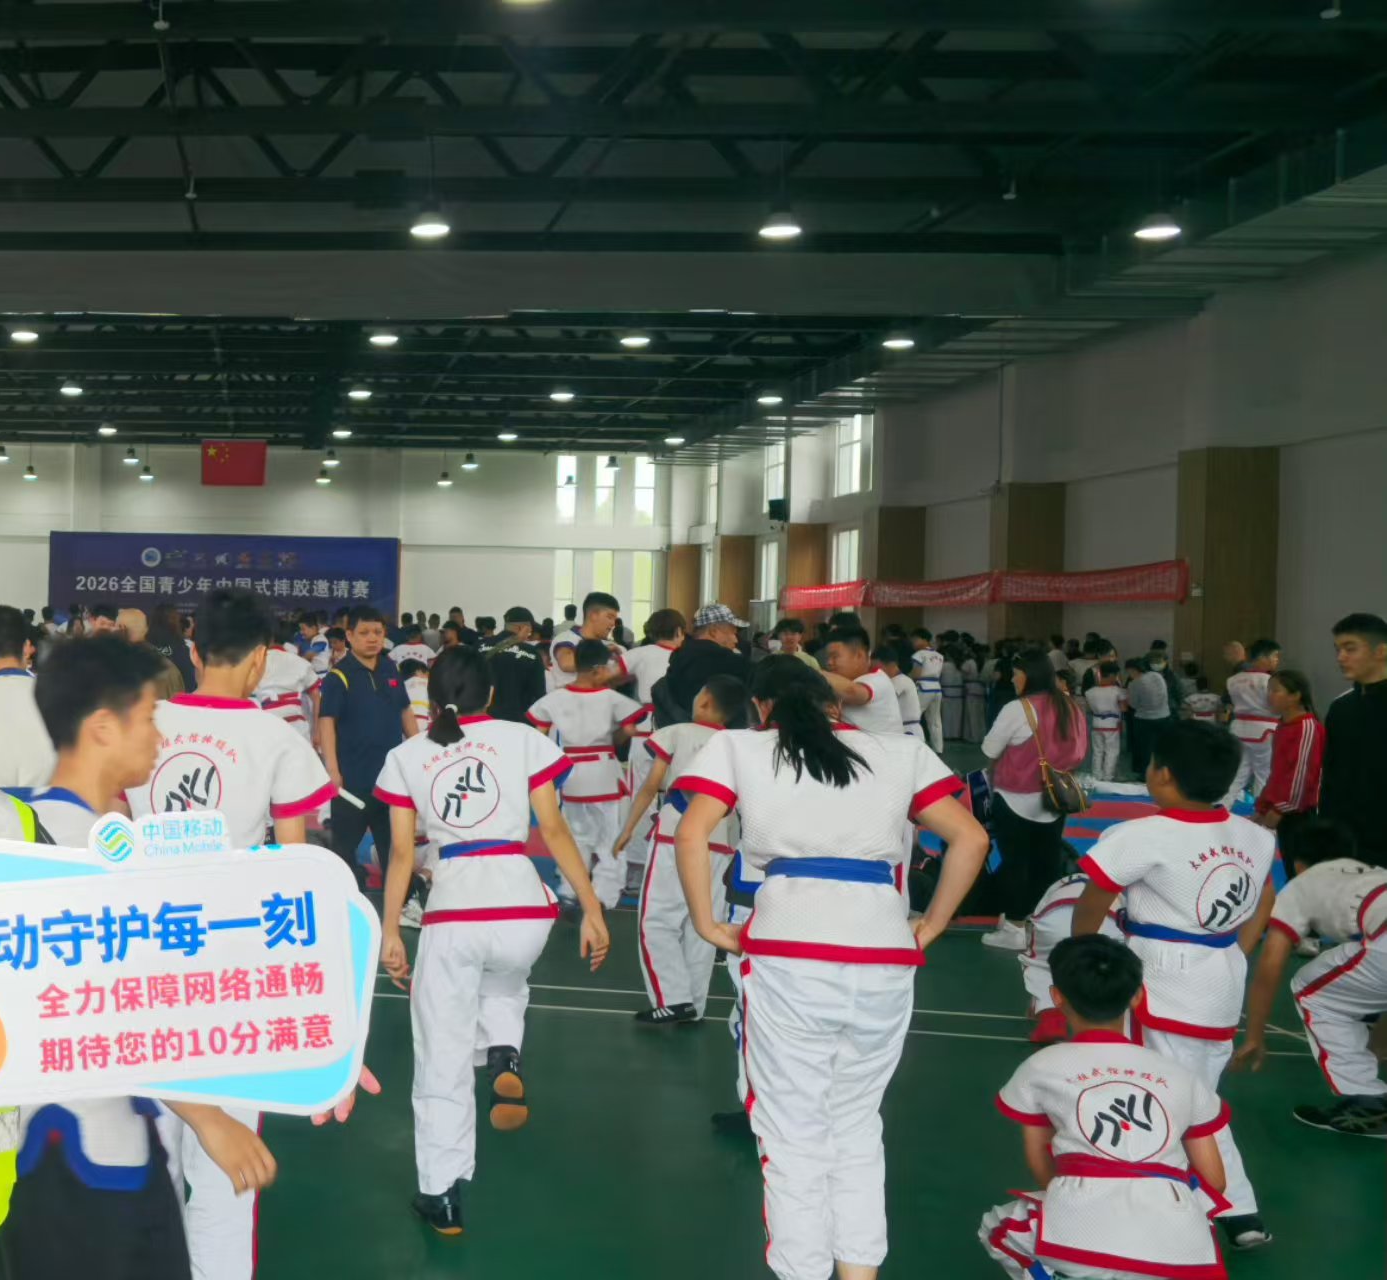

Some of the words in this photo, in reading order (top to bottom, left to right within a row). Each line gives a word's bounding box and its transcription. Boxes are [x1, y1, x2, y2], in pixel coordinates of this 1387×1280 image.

[75, 575, 370, 599] 2026全国青少年中国式摔跤邀请赛
[142, 817, 223, 841] 中国移动
[144, 843, 181, 857] China
[183, 840, 224, 855] Mobile
[37, 961, 325, 1020] 全力保障网络通畅
[39, 1014, 335, 1074] 期待您的10分满意
